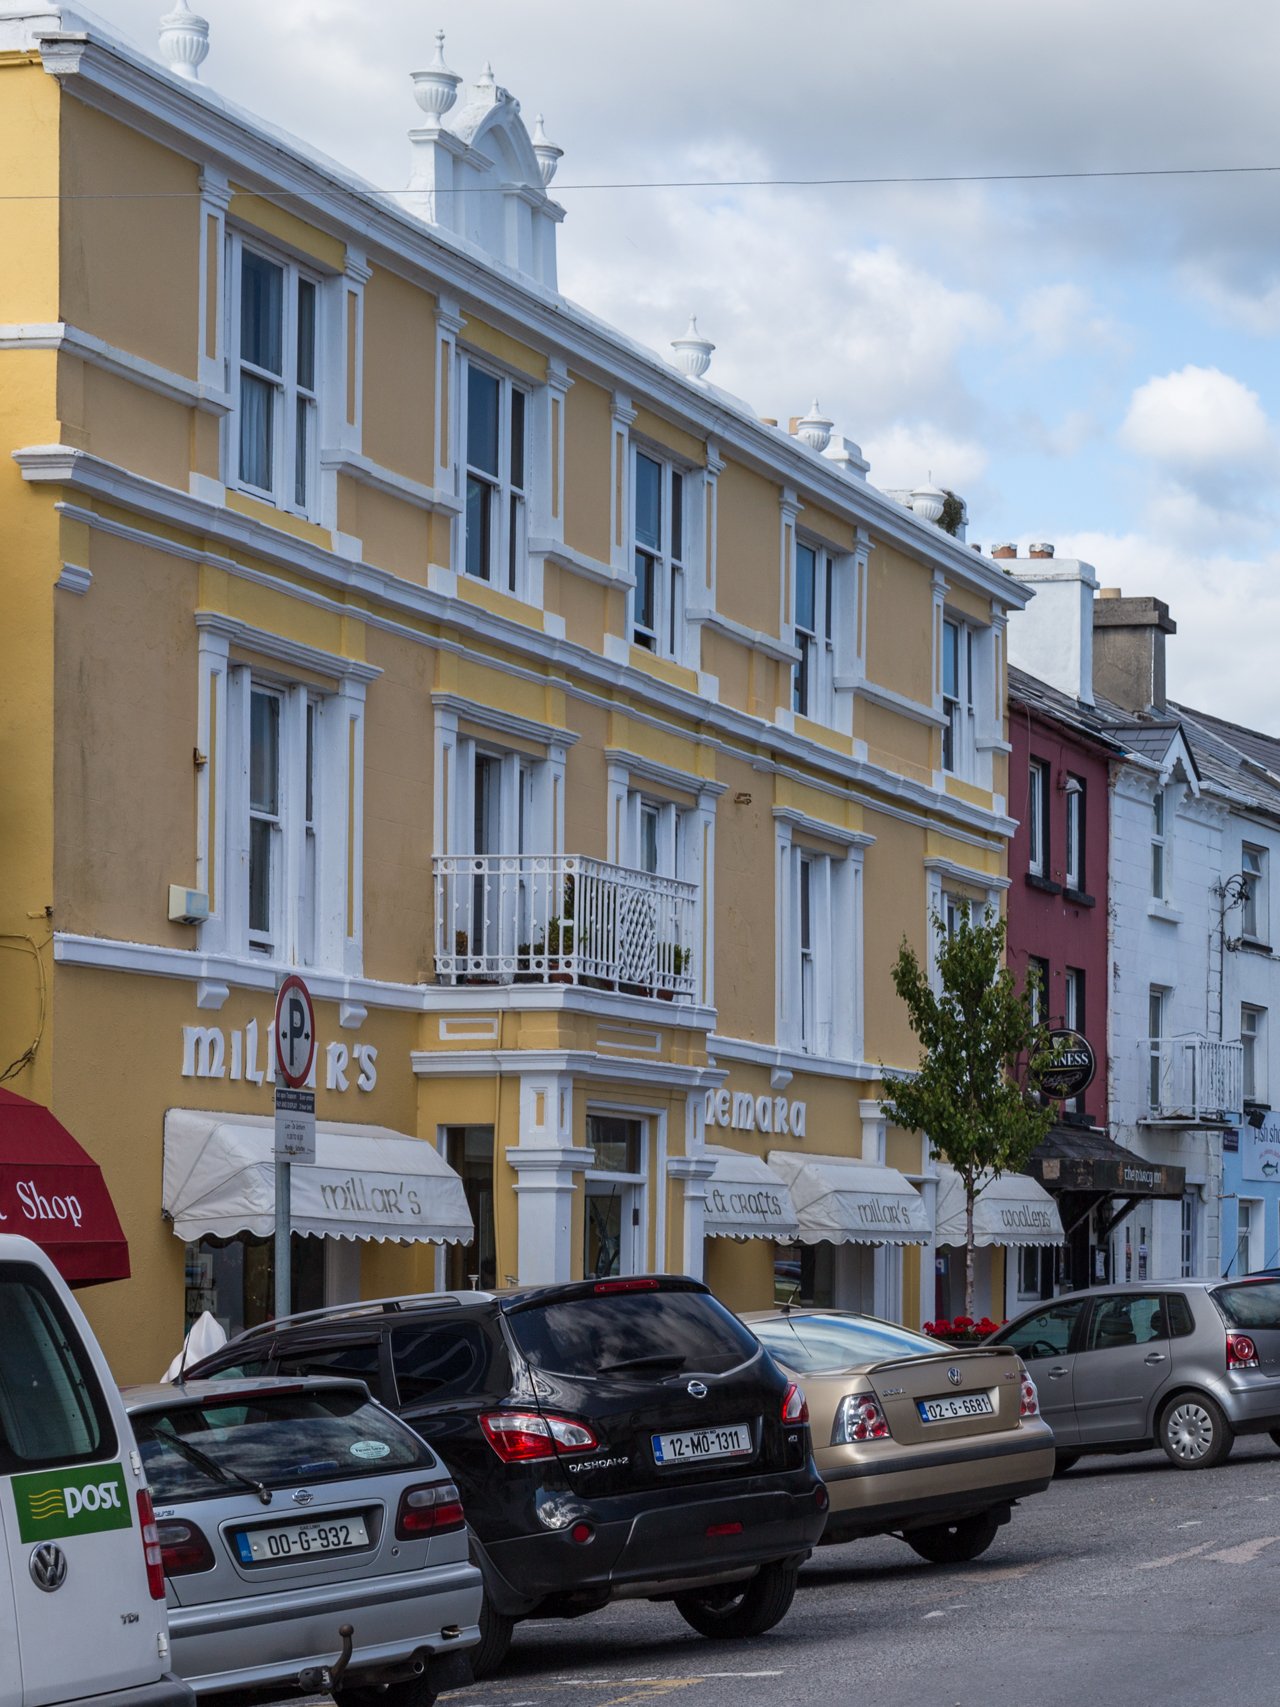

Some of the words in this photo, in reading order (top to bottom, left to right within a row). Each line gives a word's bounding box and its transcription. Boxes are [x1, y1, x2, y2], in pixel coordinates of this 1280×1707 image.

[289, 998, 305, 1066] P
[16, 1180, 82, 1228] Shop
[729, 1191, 782, 1222] crafts
[1001, 1205, 1050, 1227] woollens
[928, 1397, 989, 1418] 02-G-6681
[670, 1430, 741, 1457] 12-MO-1311
[267, 1525, 352, 1556] 00-G-932
[120, 1613, 140, 1625] TDI
